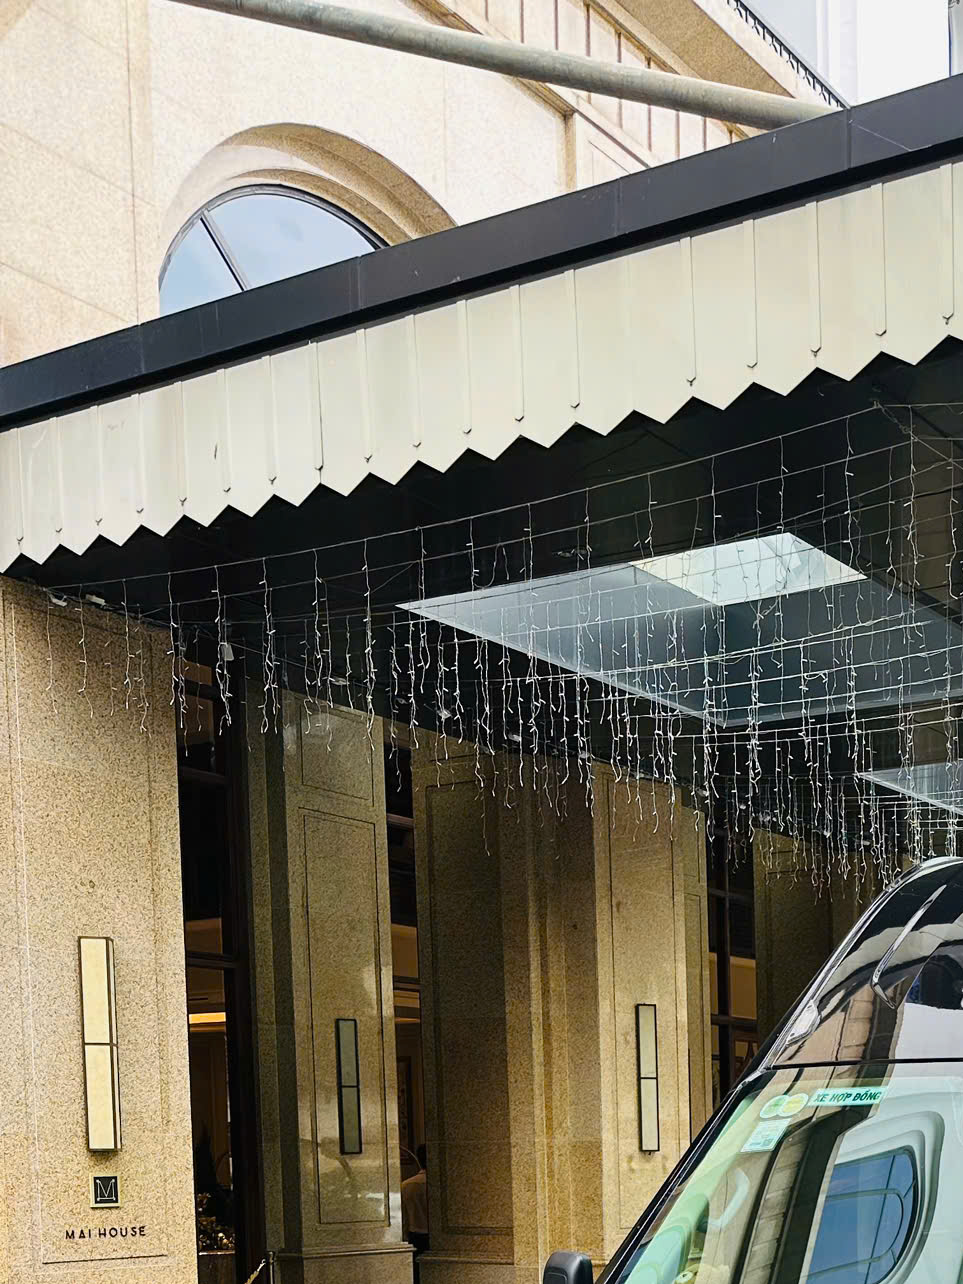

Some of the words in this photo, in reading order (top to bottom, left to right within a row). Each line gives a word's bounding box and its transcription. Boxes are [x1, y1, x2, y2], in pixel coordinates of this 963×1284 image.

[814, 1093, 829, 1102] XE
[65, 1229, 91, 1239] MAI
[98, 1226, 146, 1238] HOUSE
